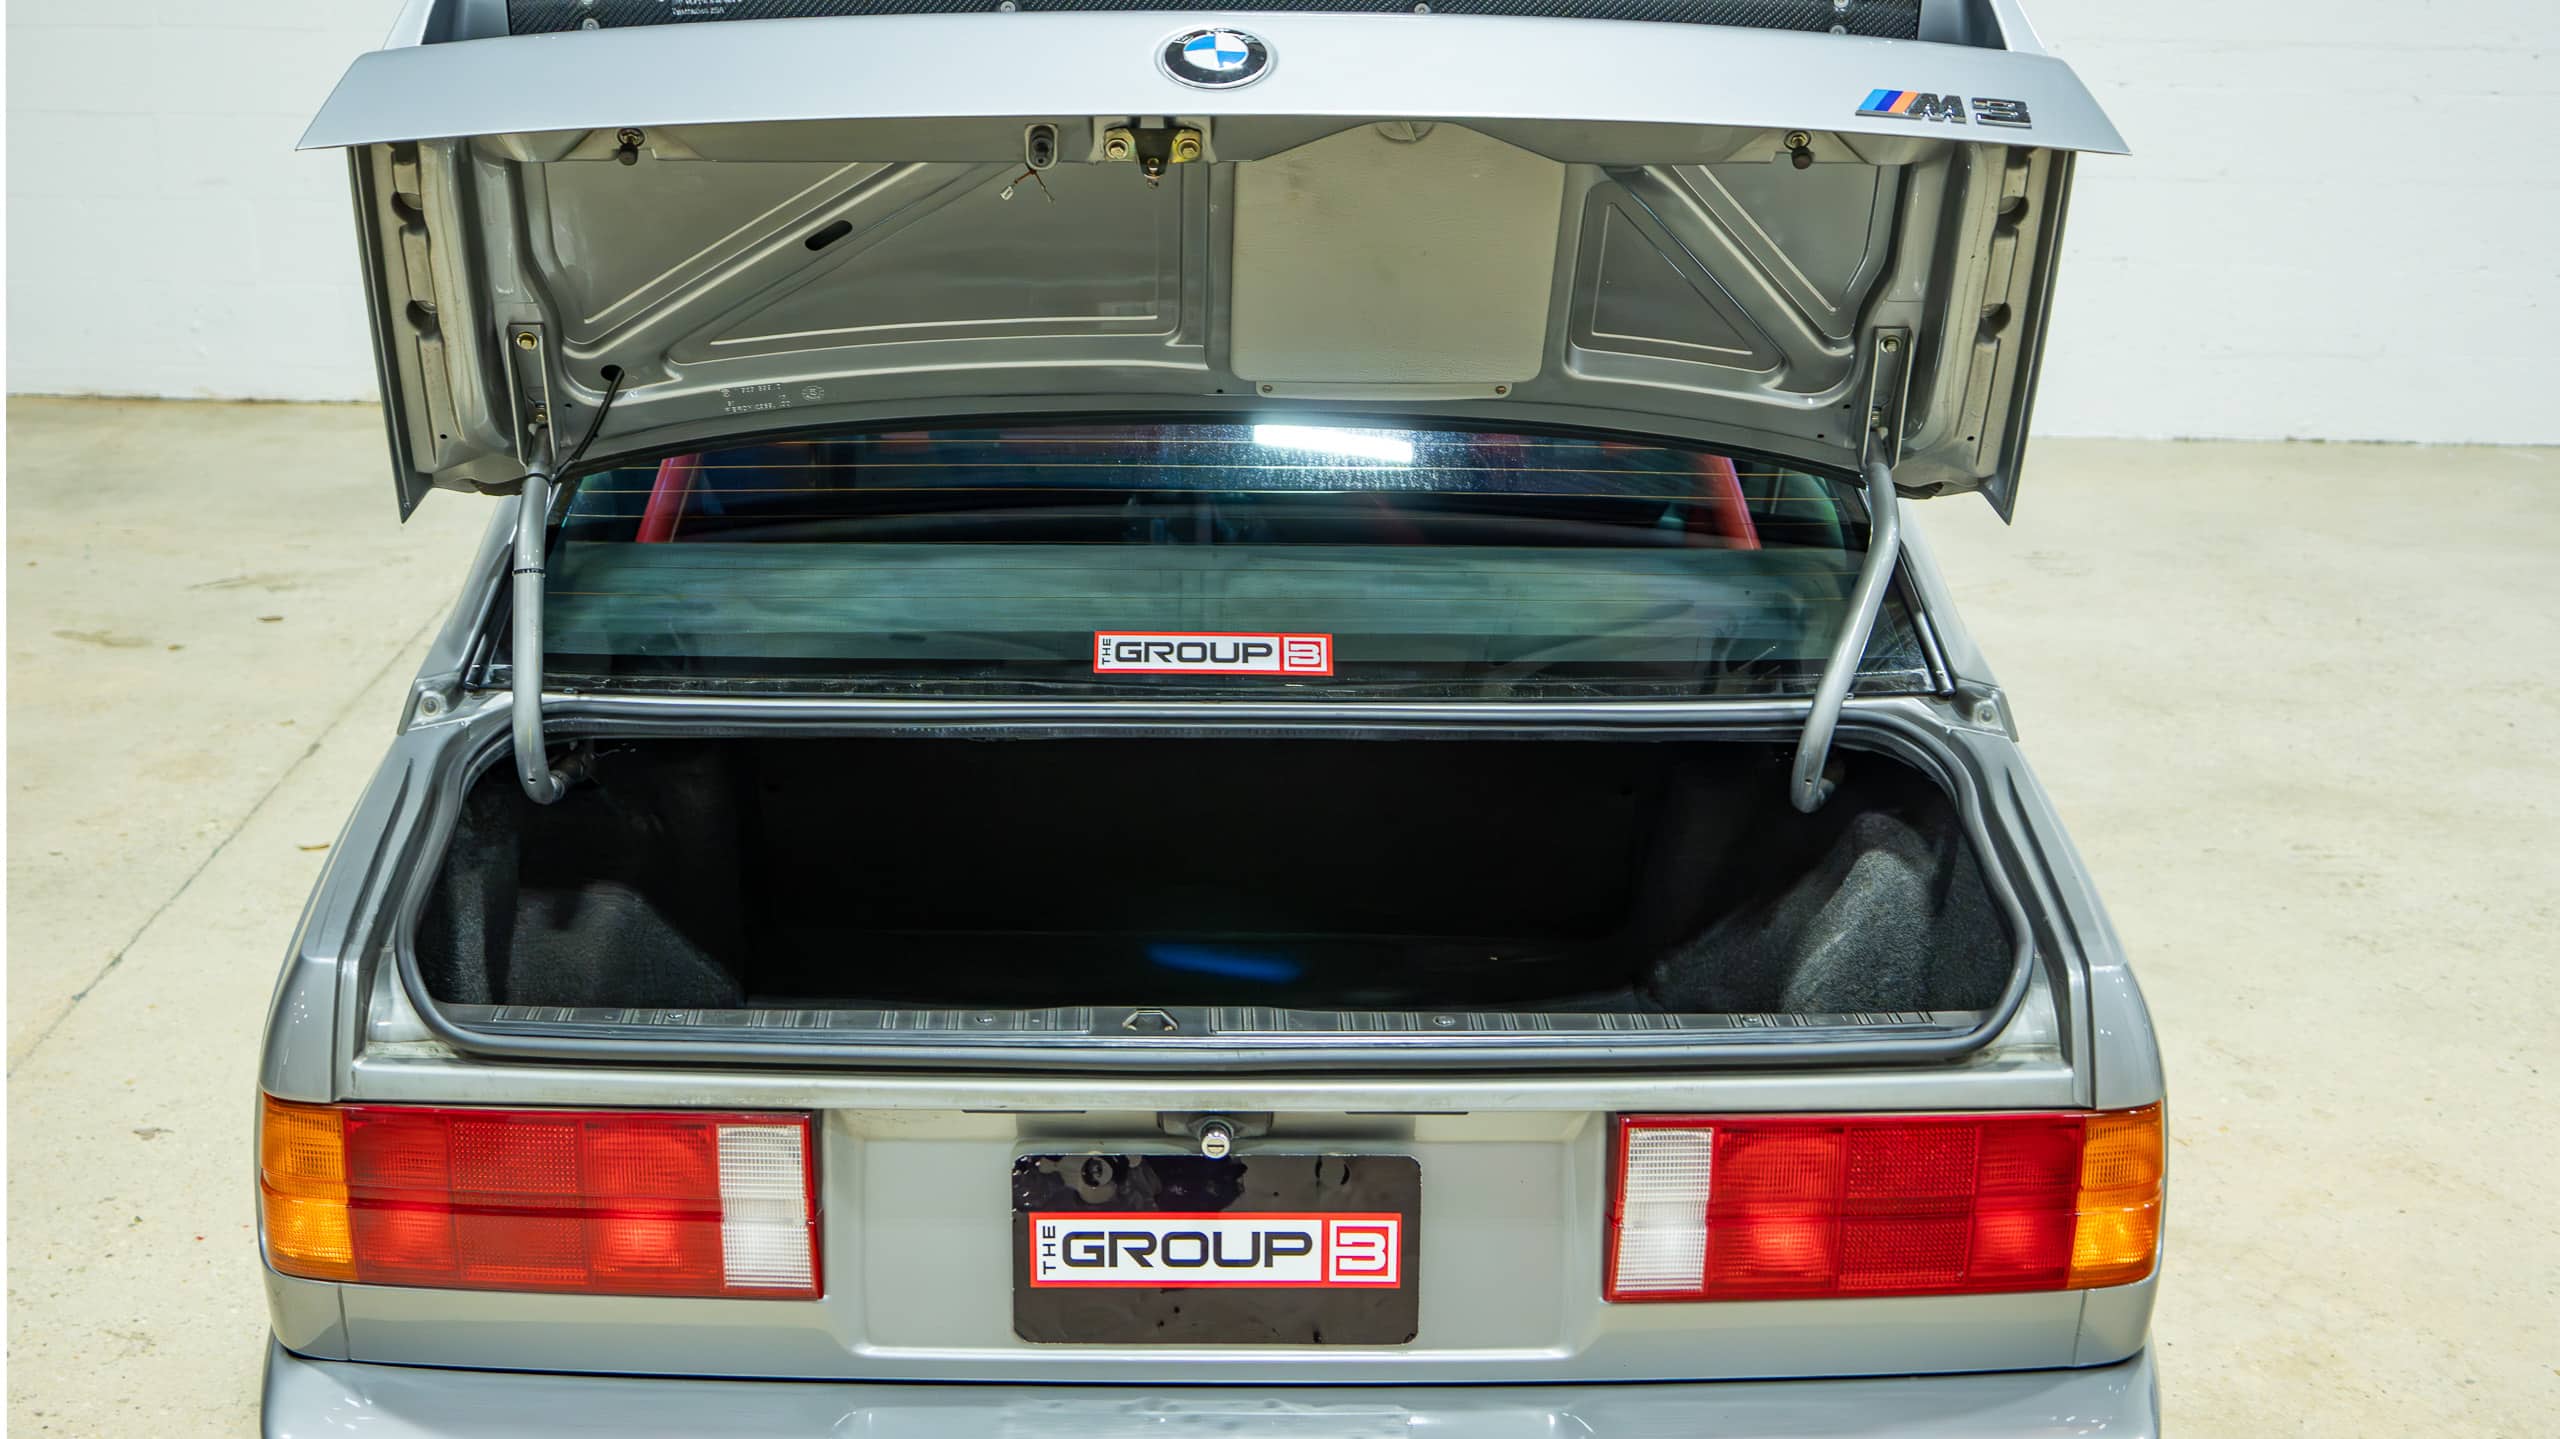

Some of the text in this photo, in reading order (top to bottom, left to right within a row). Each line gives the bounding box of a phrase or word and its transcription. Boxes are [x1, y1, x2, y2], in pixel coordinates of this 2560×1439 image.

[1905, 93, 2032, 129] M3
[1101, 637, 1112, 666] THE
[1114, 641, 1273, 664] GROUP
[1042, 1224, 1387, 1275] THE GROUP 3
